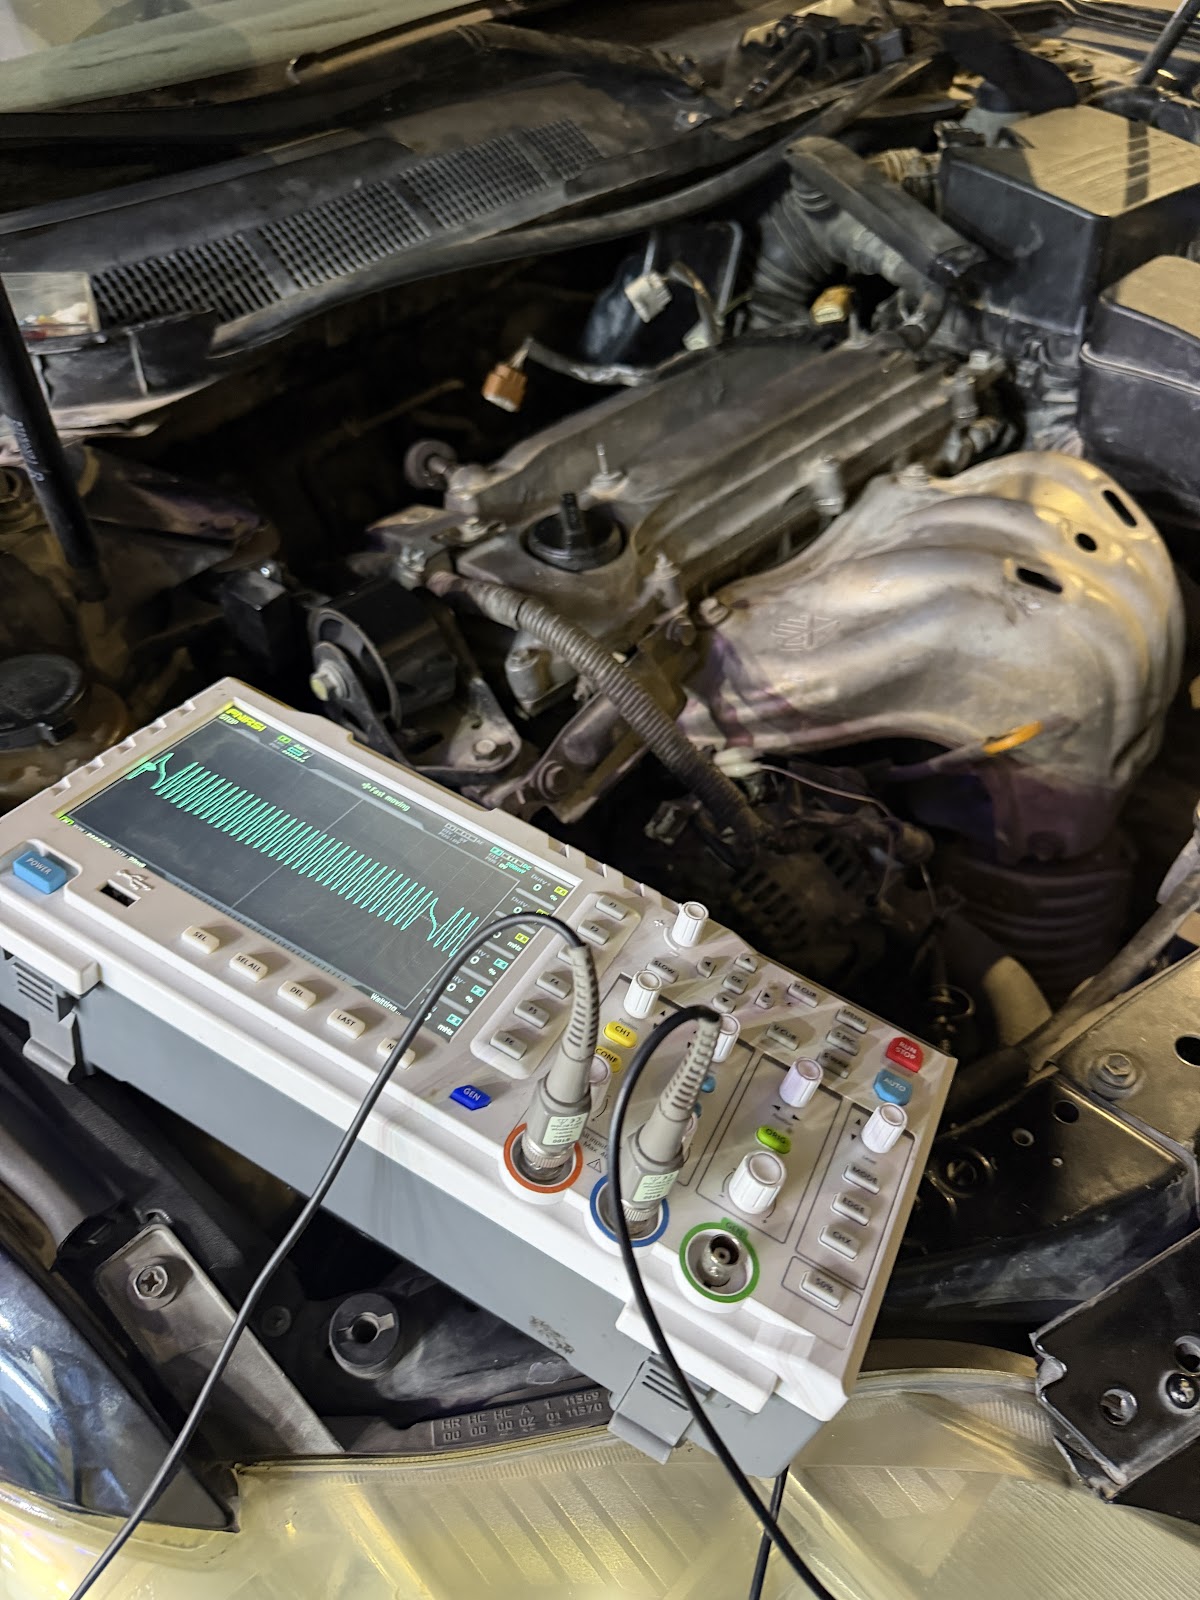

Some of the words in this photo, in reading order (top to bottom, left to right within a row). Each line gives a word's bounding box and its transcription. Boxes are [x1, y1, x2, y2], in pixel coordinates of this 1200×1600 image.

[225, 708, 267, 732] FNIRSI
[369, 786, 386, 798] Fast
[384, 795, 411, 812] moving
[25, 857, 52, 875] POWER
[192, 931, 208, 942] SEL
[236, 955, 249, 966] SEL
[248, 962, 262, 973] ALL
[653, 960, 675, 975] SLOW
[289, 986, 305, 998] DEL
[336, 1013, 357, 1027] LAST
[614, 1025, 631, 1037] CH1
[895, 1046, 916, 1059] STOP
[898, 1041, 917, 1054] RUN
[883, 1078, 906, 1091] AUTO
[463, 1087, 482, 1101] GEN
[765, 1128, 786, 1144] ORIG
[852, 1166, 878, 1184] MODE
[842, 1197, 865, 1214] EDGE
[442, 1417, 461, 1430] HR
[468, 1413, 488, 1425] HC
[494, 1408, 513, 1420] HC
[520, 1404, 531, 1415] A
[444, 1430, 461, 1441] 00
[470, 1424, 488, 1437] 00
[497, 1420, 515, 1432] 00
